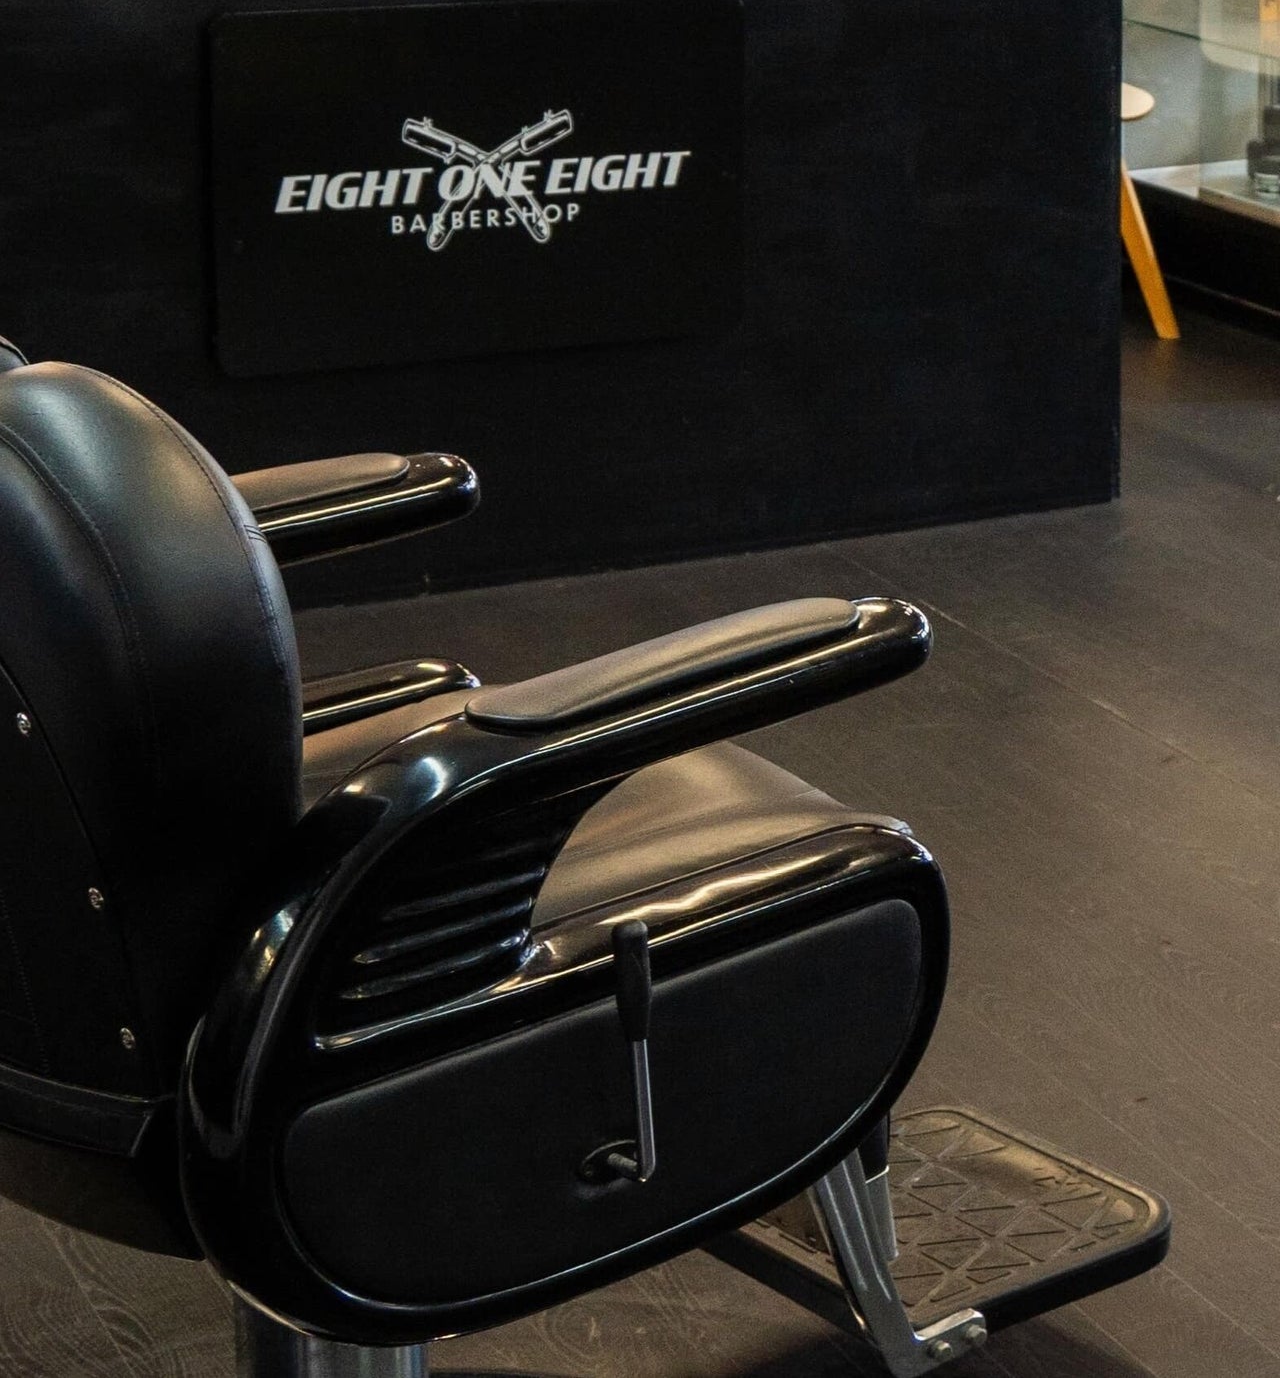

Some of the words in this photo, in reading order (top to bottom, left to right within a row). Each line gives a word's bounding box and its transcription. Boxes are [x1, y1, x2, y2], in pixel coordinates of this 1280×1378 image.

[274, 167, 433, 214] EIGHT
[438, 160, 541, 202] ONE
[545, 151, 691, 195] EIGHT
[391, 203, 580, 235] BARBERSHOP
